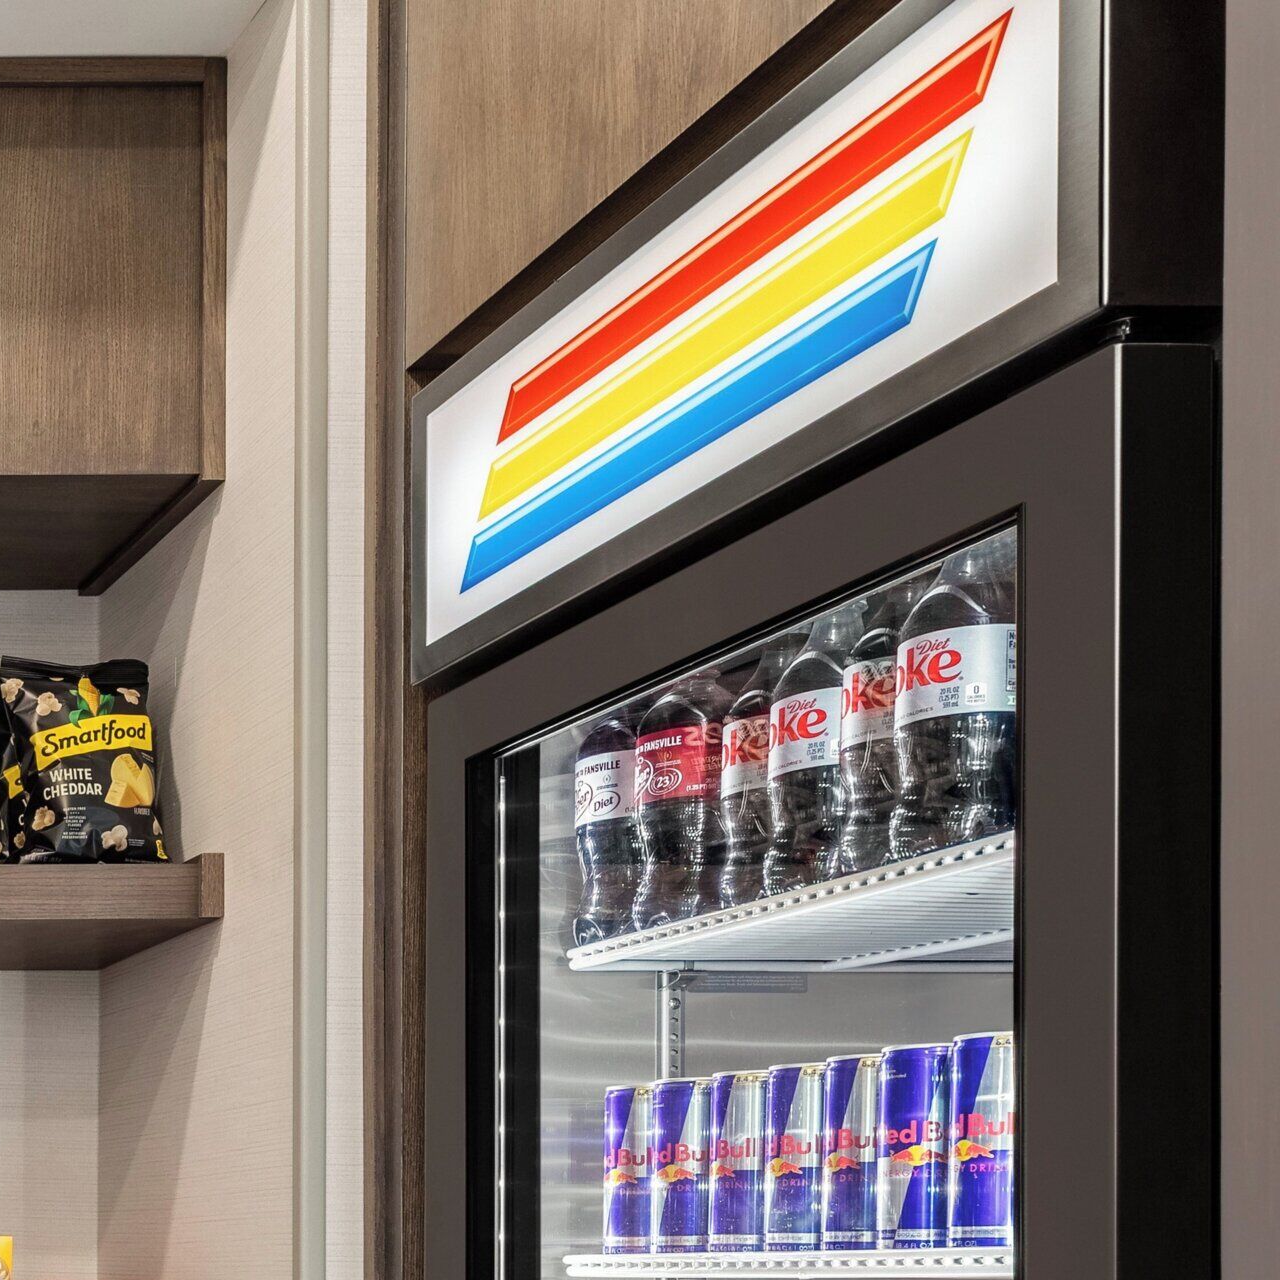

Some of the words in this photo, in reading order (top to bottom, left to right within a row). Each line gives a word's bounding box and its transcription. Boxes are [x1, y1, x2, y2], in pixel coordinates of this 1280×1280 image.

[916, 638, 951, 655] Diet
[787, 699, 817, 714] Diet
[41, 719, 147, 757] Smartfood
[643, 735, 682, 752] FANSVILLE
[49, 768, 92, 783] WHITE
[584, 760, 621, 775] FANSVILLE
[656, 775, 670, 788] 23
[43, 782, 103, 800] CHEDDAR
[594, 796, 613, 812] Diet
[717, 1137, 756, 1159] Bull
